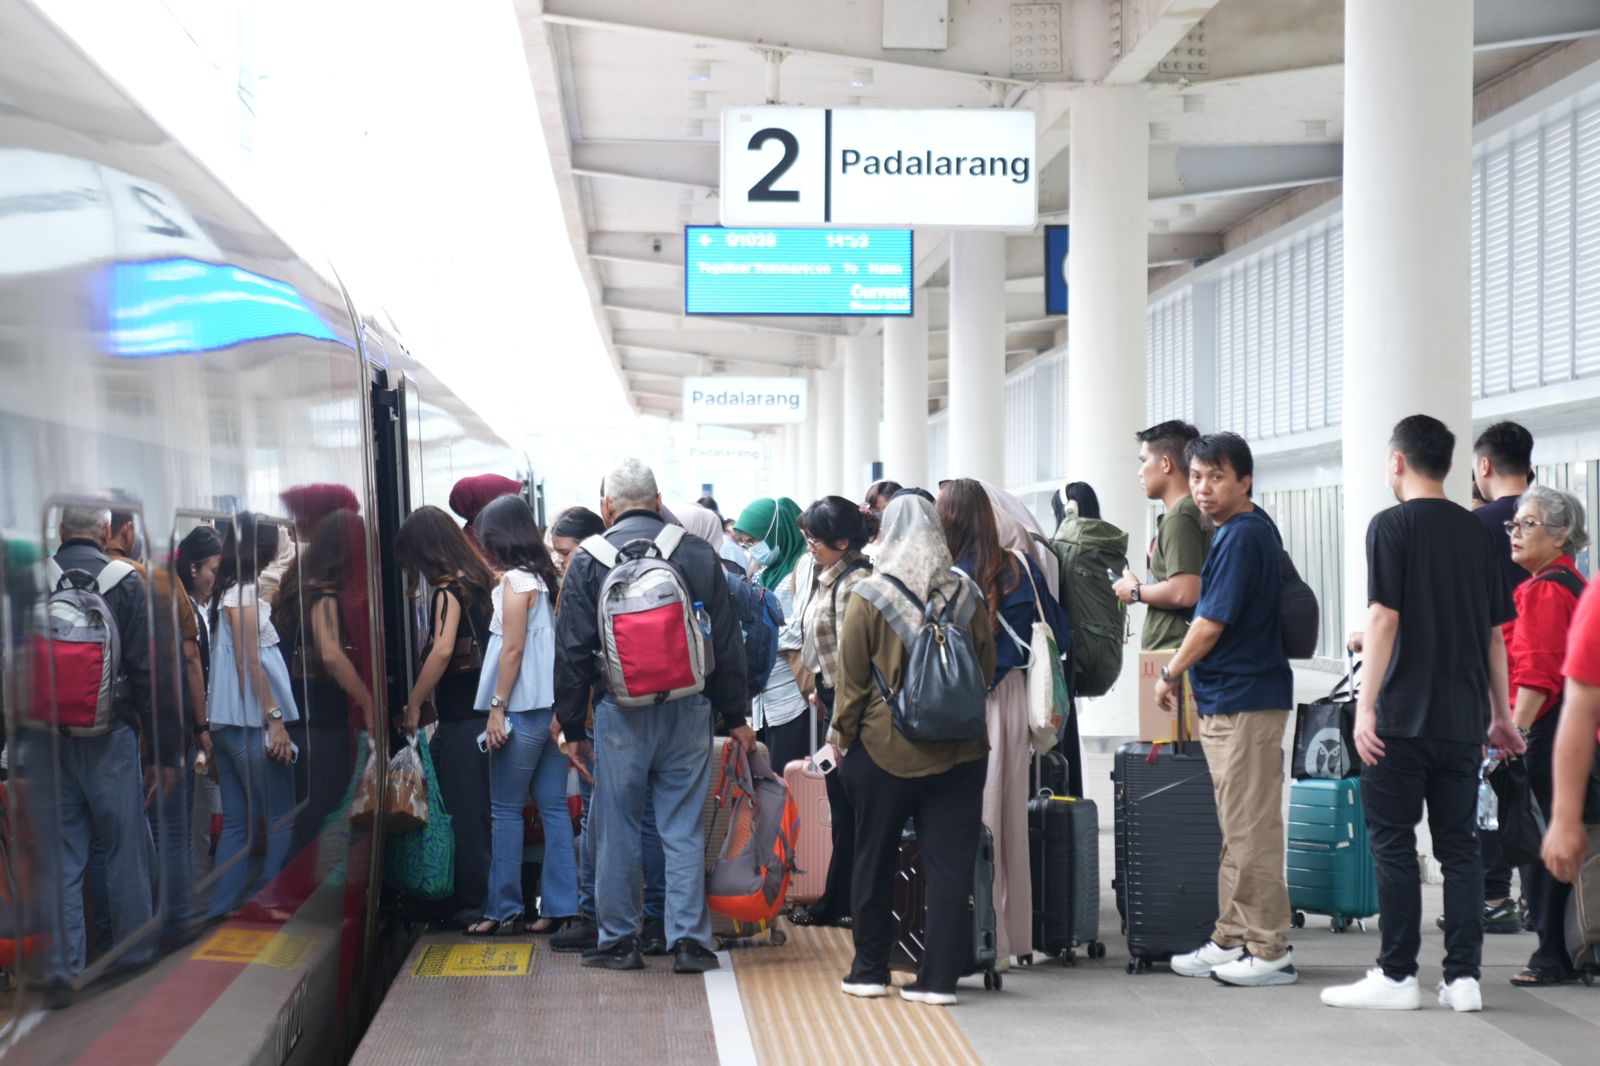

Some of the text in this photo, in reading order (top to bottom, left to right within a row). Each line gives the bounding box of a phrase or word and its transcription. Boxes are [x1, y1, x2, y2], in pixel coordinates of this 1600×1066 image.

[748, 128, 800, 203] 2
[841, 148, 1030, 185] Padalarang
[850, 284, 909, 300] Current
[692, 391, 800, 410] Padalarang
[689, 448, 760, 460] Padalarang
